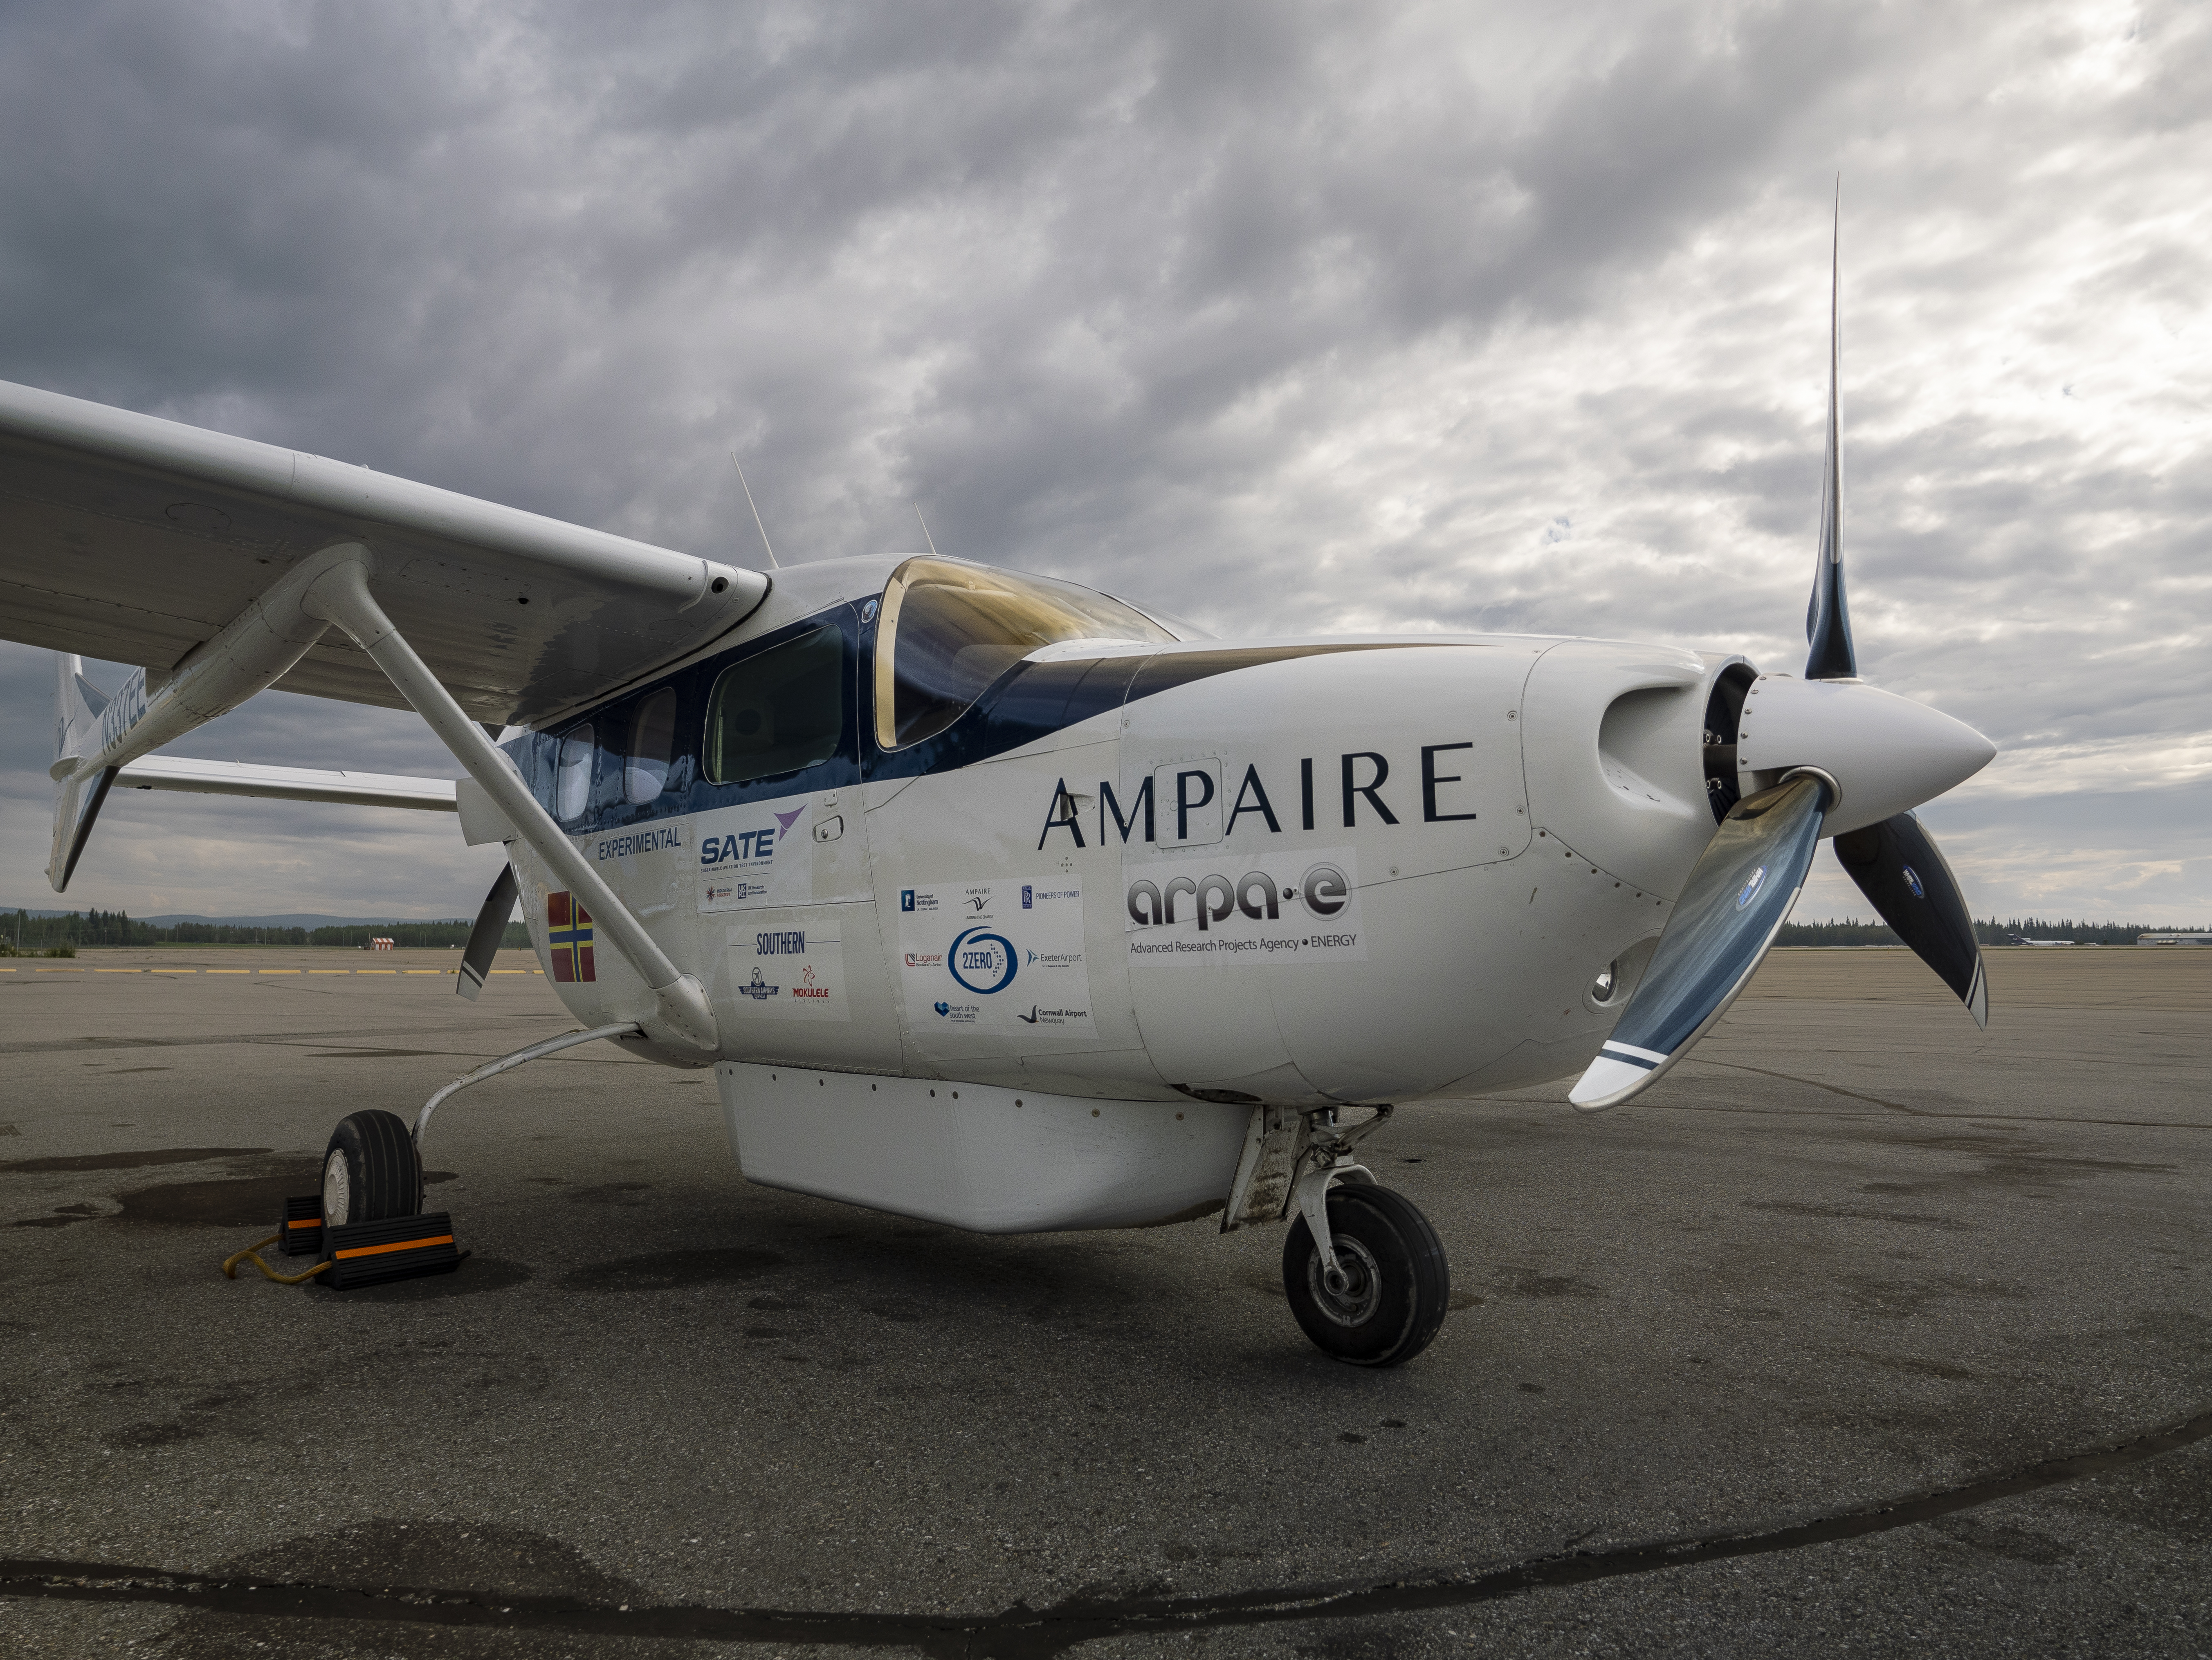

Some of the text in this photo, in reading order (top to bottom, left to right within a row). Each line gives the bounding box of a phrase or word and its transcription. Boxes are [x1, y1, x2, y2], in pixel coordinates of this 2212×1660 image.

[1037, 742, 1477, 851] AMPAIRE
[599, 827, 681, 861] EXPERIMENTAL
[701, 828, 776, 865] SATE
[1064, 890, 1080, 898] POWER
[757, 931, 805, 955] SOUTHERN
[1130, 934, 1356, 953] Advanced Research Projects Agency ENERGY
[916, 953, 943, 963] Loganair
[962, 951, 993, 969] 2ZERO
[792, 988, 829, 998] MOKULELE
[1040, 1016, 1064, 1025] Newquay
[1065, 1009, 1087, 1018] Airport
